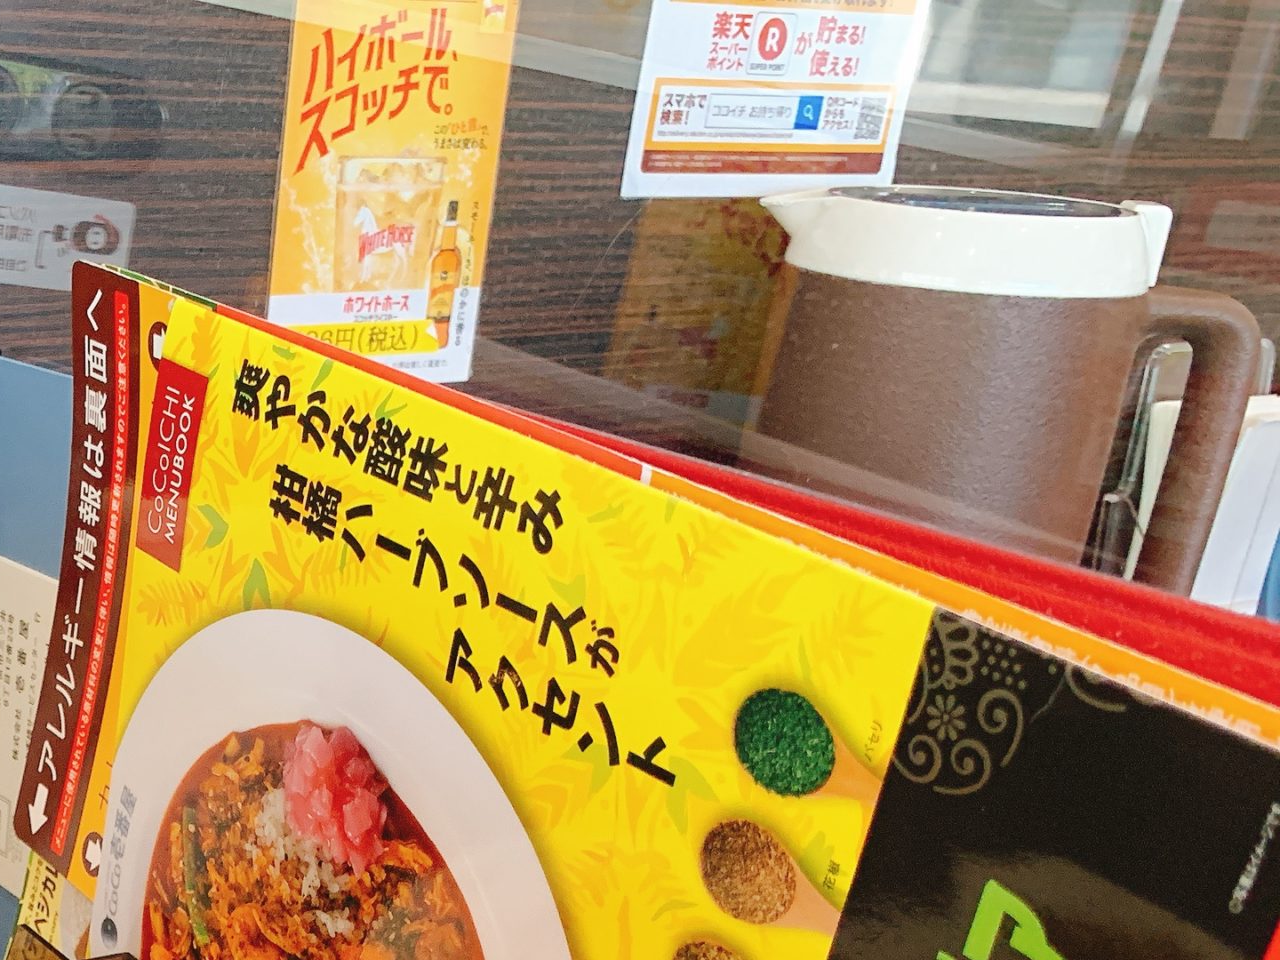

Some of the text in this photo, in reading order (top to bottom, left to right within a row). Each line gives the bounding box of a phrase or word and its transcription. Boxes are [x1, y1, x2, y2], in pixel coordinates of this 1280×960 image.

[303, 8, 458, 106] ハイボール、
[706, 56, 744, 71] ポイント
[709, 42, 748, 54] スーパー
[712, 12, 754, 40] 楽天
[795, 32, 813, 56] が
[294, 66, 453, 175] スコッチで。
[662, 93, 707, 108] スマホで
[712, 104, 747, 118] ココイチ
[343, 295, 410, 313] ホワイトホース
[148, 386, 180, 533] CoCoICHI
[164, 393, 195, 544] MENUBOOK
[232, 358, 563, 554] 爽やかな酸味と辛み
[38, 288, 108, 781] アレルギー情報は裏面へ
[268, 463, 620, 677] 柑橘ハーブソースが
[445, 627, 676, 787] アクセント
